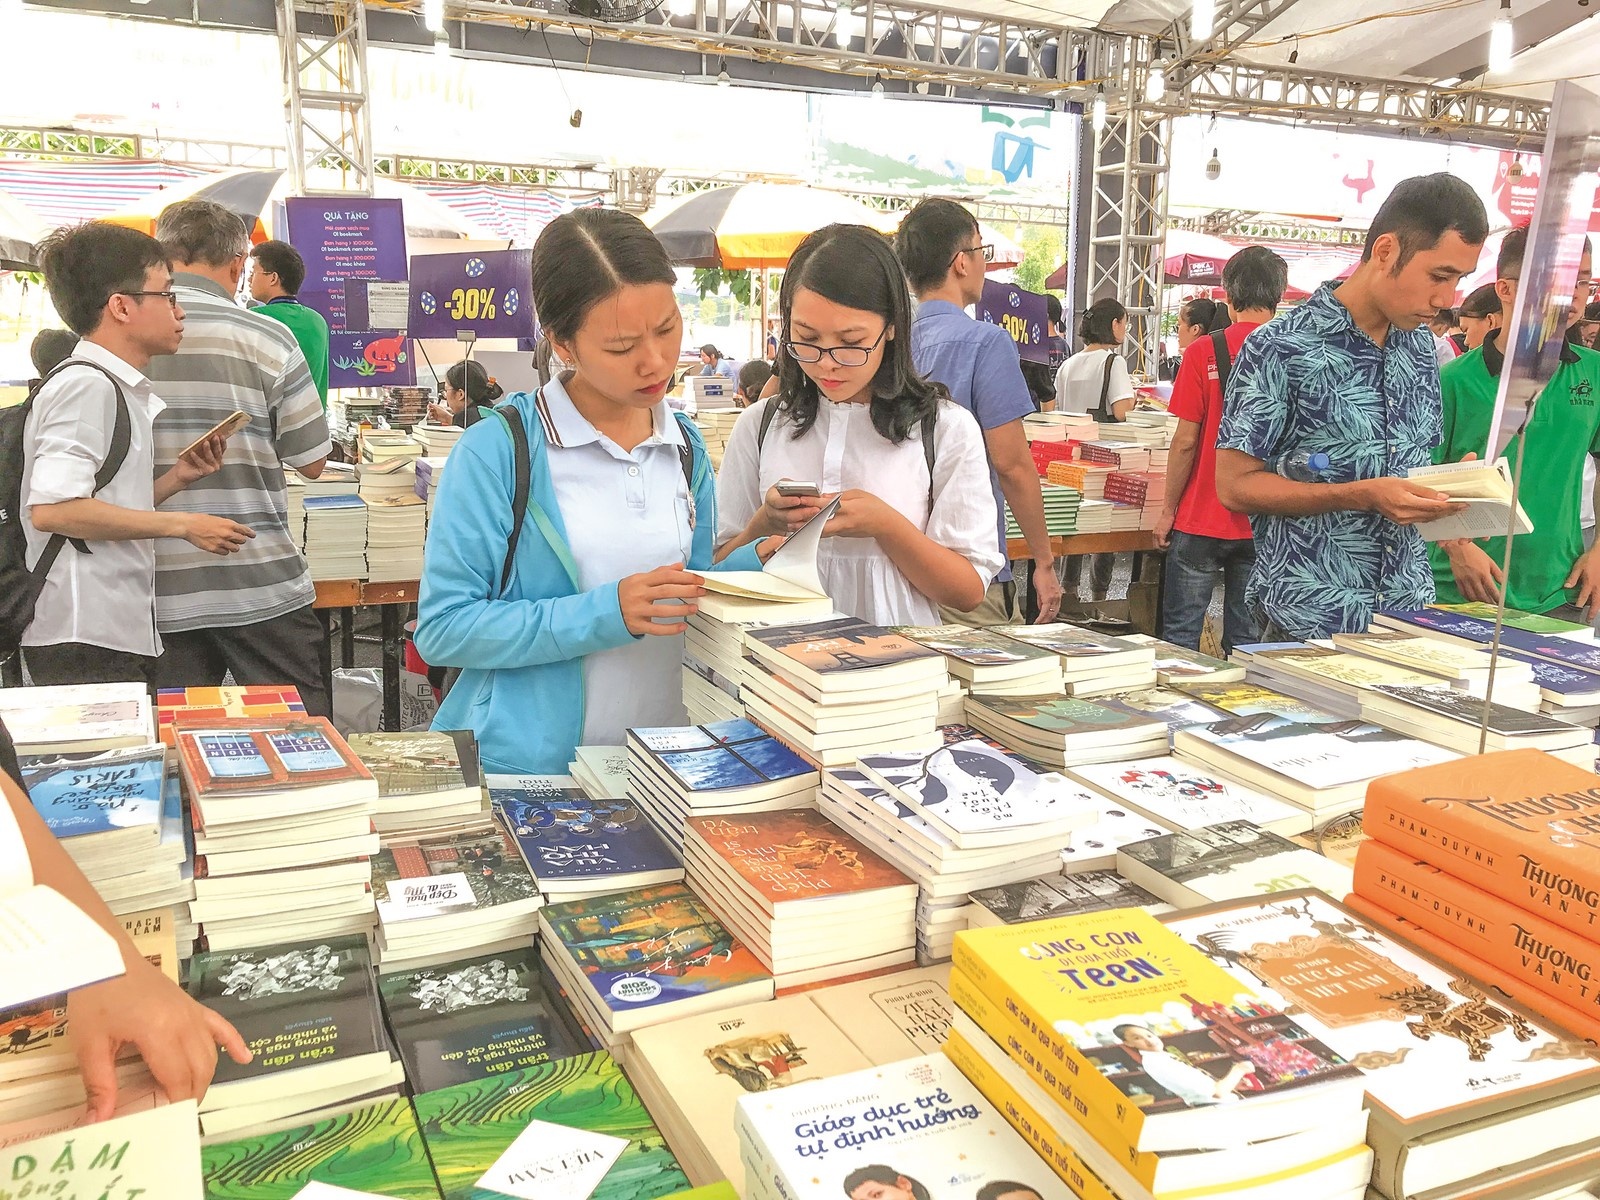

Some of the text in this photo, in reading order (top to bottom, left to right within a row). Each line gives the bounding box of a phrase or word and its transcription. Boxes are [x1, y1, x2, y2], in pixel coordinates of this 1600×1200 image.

[323, 210, 369, 222] QUÀ TẶNG
[444, 287, 496, 321] -30%
[134, 924, 160, 935] LAM
[1090, 931, 1143, 948] CON
[620, 980, 648, 990] 2018
[795, 1088, 962, 1138] Giáo dục trẻ
[795, 1139, 829, 1160] tự
[834, 1125, 896, 1151] định
[897, 1104, 983, 1133] hướng
[11, 1138, 130, 1181] DẶM
